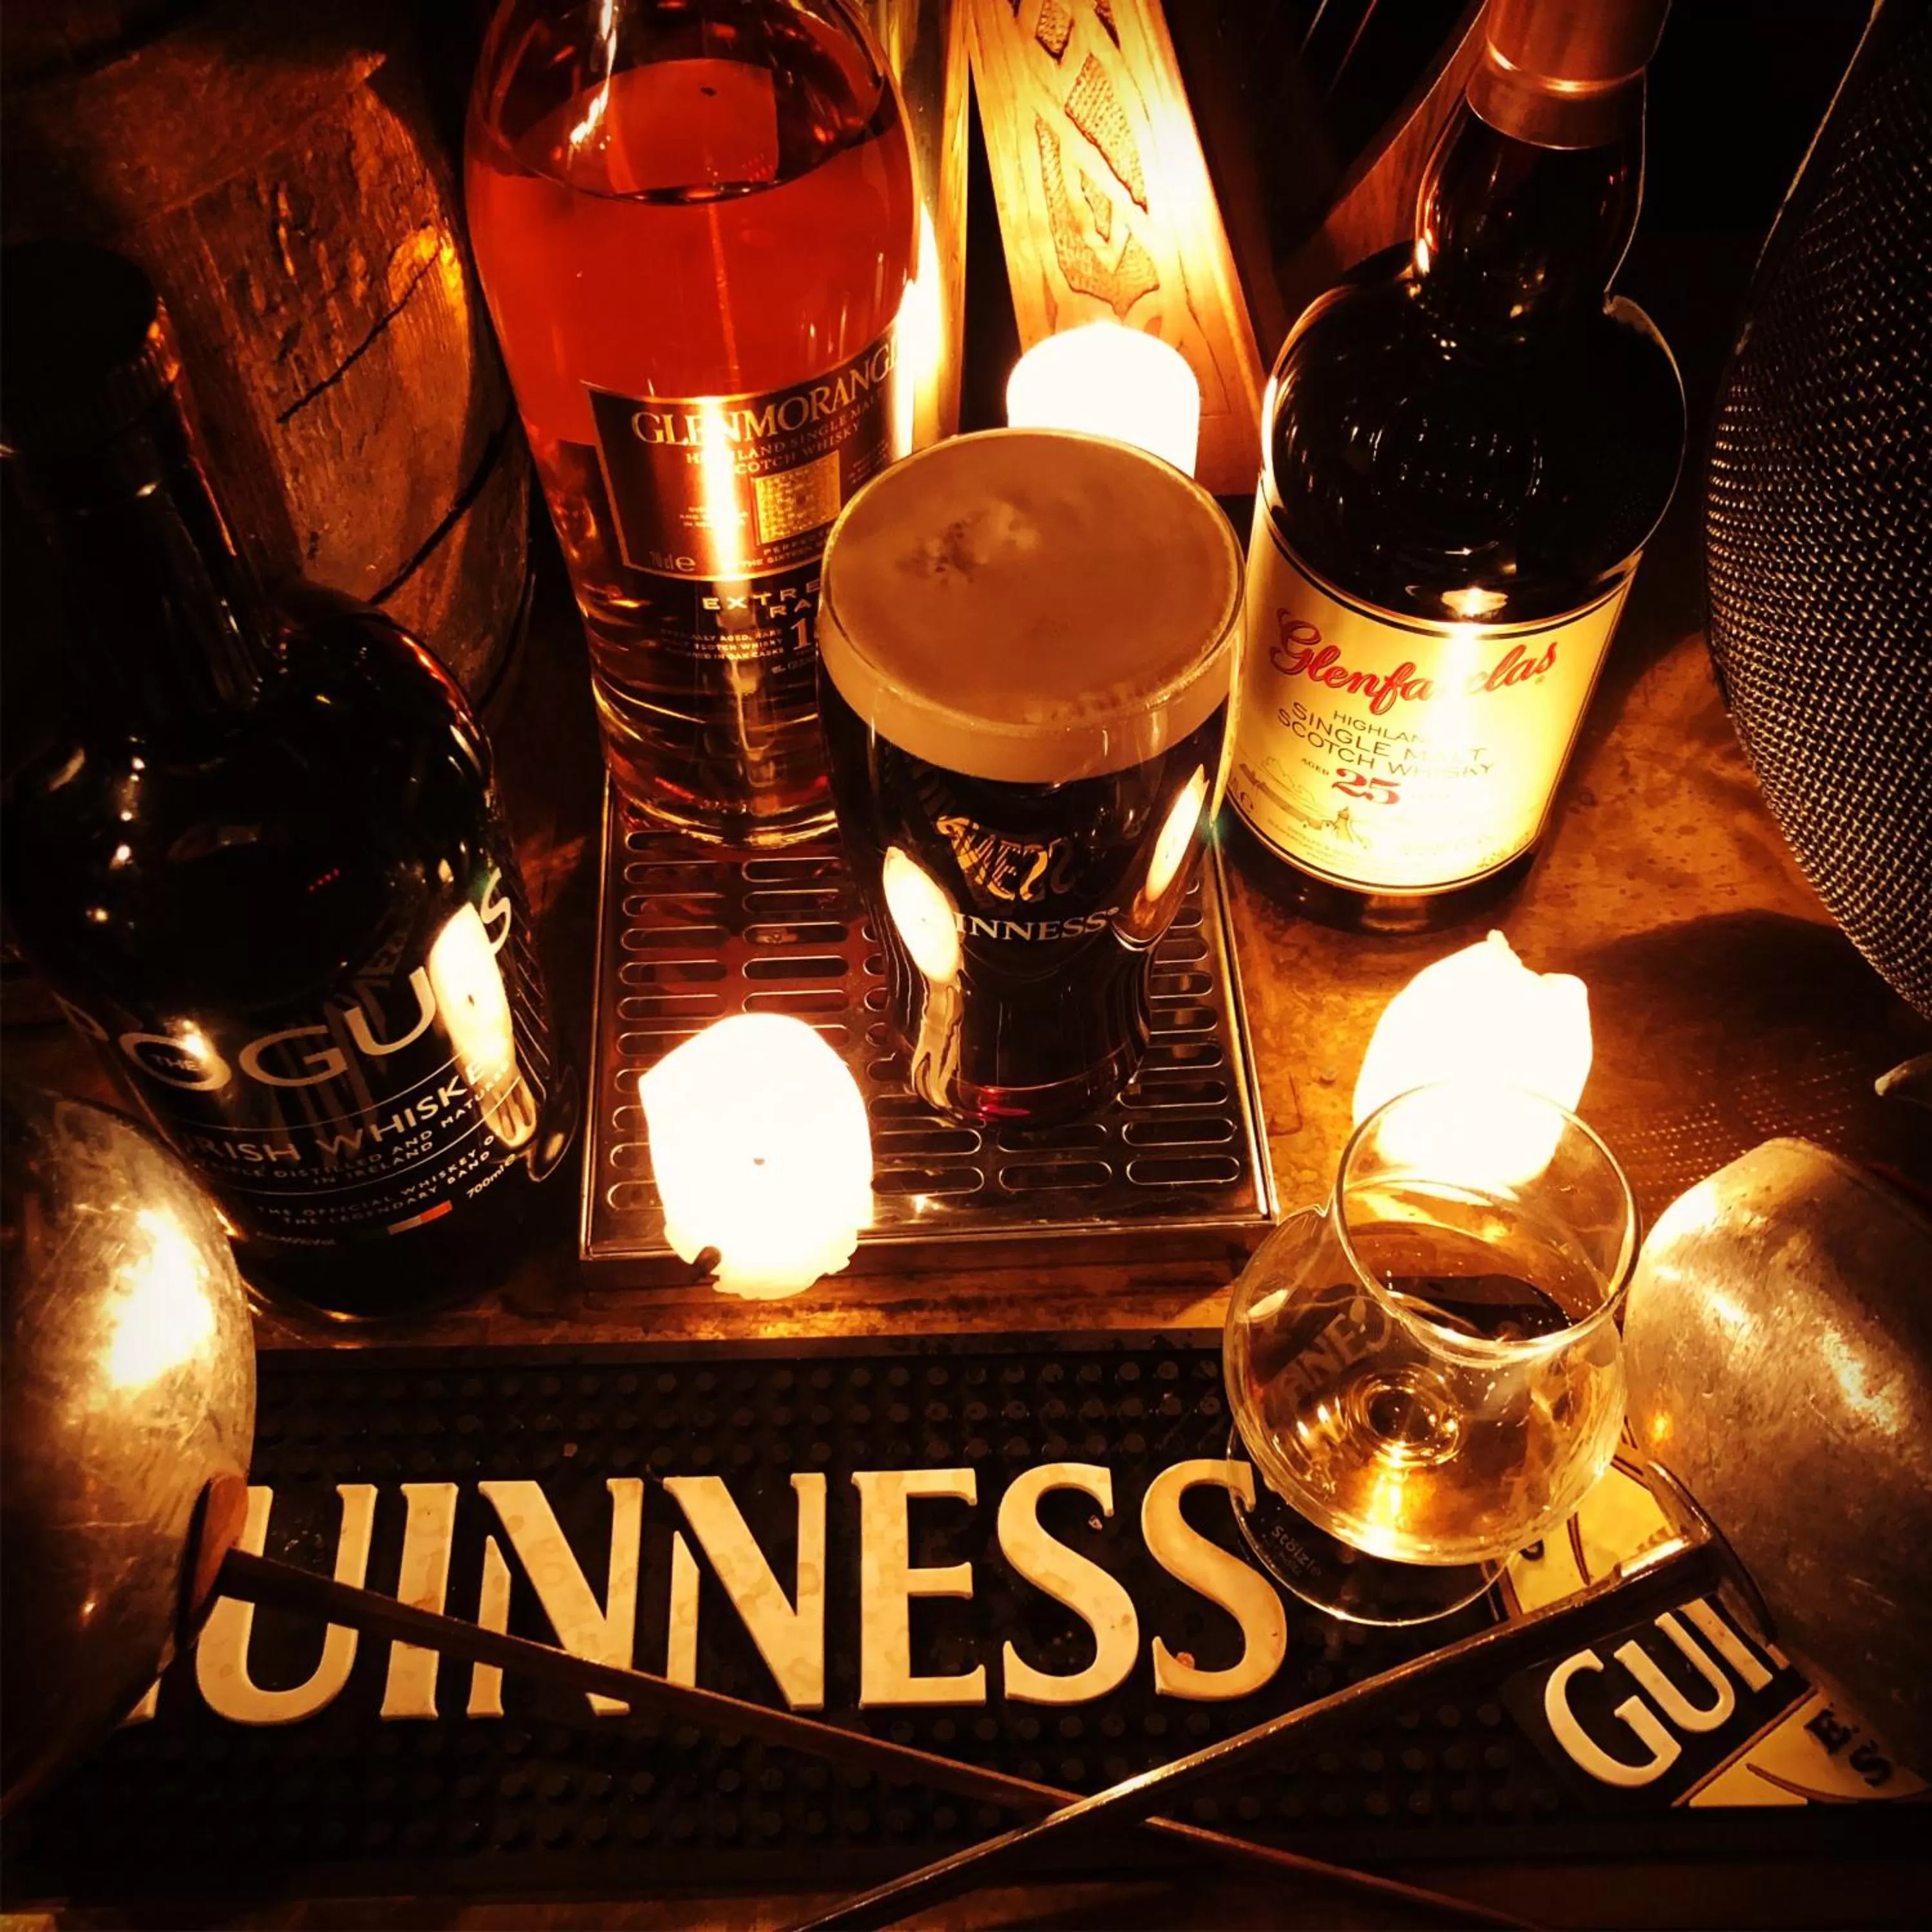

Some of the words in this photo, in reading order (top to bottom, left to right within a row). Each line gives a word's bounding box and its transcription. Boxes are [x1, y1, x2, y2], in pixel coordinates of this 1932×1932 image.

[632, 339, 897, 446] GLENMORANGI
[687, 441, 786, 464] HLAND
[733, 450, 797, 475] COTCH
[701, 578, 821, 611] EXTRE
[770, 598, 812, 619] RA
[789, 617, 813, 650] 1
[1270, 608, 1558, 716] Glenfaclas
[1277, 706, 1377, 770] SCOTCH
[1388, 760, 1495, 779] WHSKY
[1291, 701, 1392, 758] SINGLE
[1332, 710, 1425, 744] HIGHLAN
[1300, 757, 1331, 776] AGED
[1331, 766, 1403, 805] 25
[952, 907, 1121, 941] INNESS
[314, 1061, 486, 1157] WHISKE
[391, 1129, 433, 1156] AND
[399, 1148, 477, 1197] WHISKEY
[446, 1151, 490, 1186] BAND
[122, 1458, 1288, 1725] UINNESS
[1544, 1596, 1791, 1788] GUI
